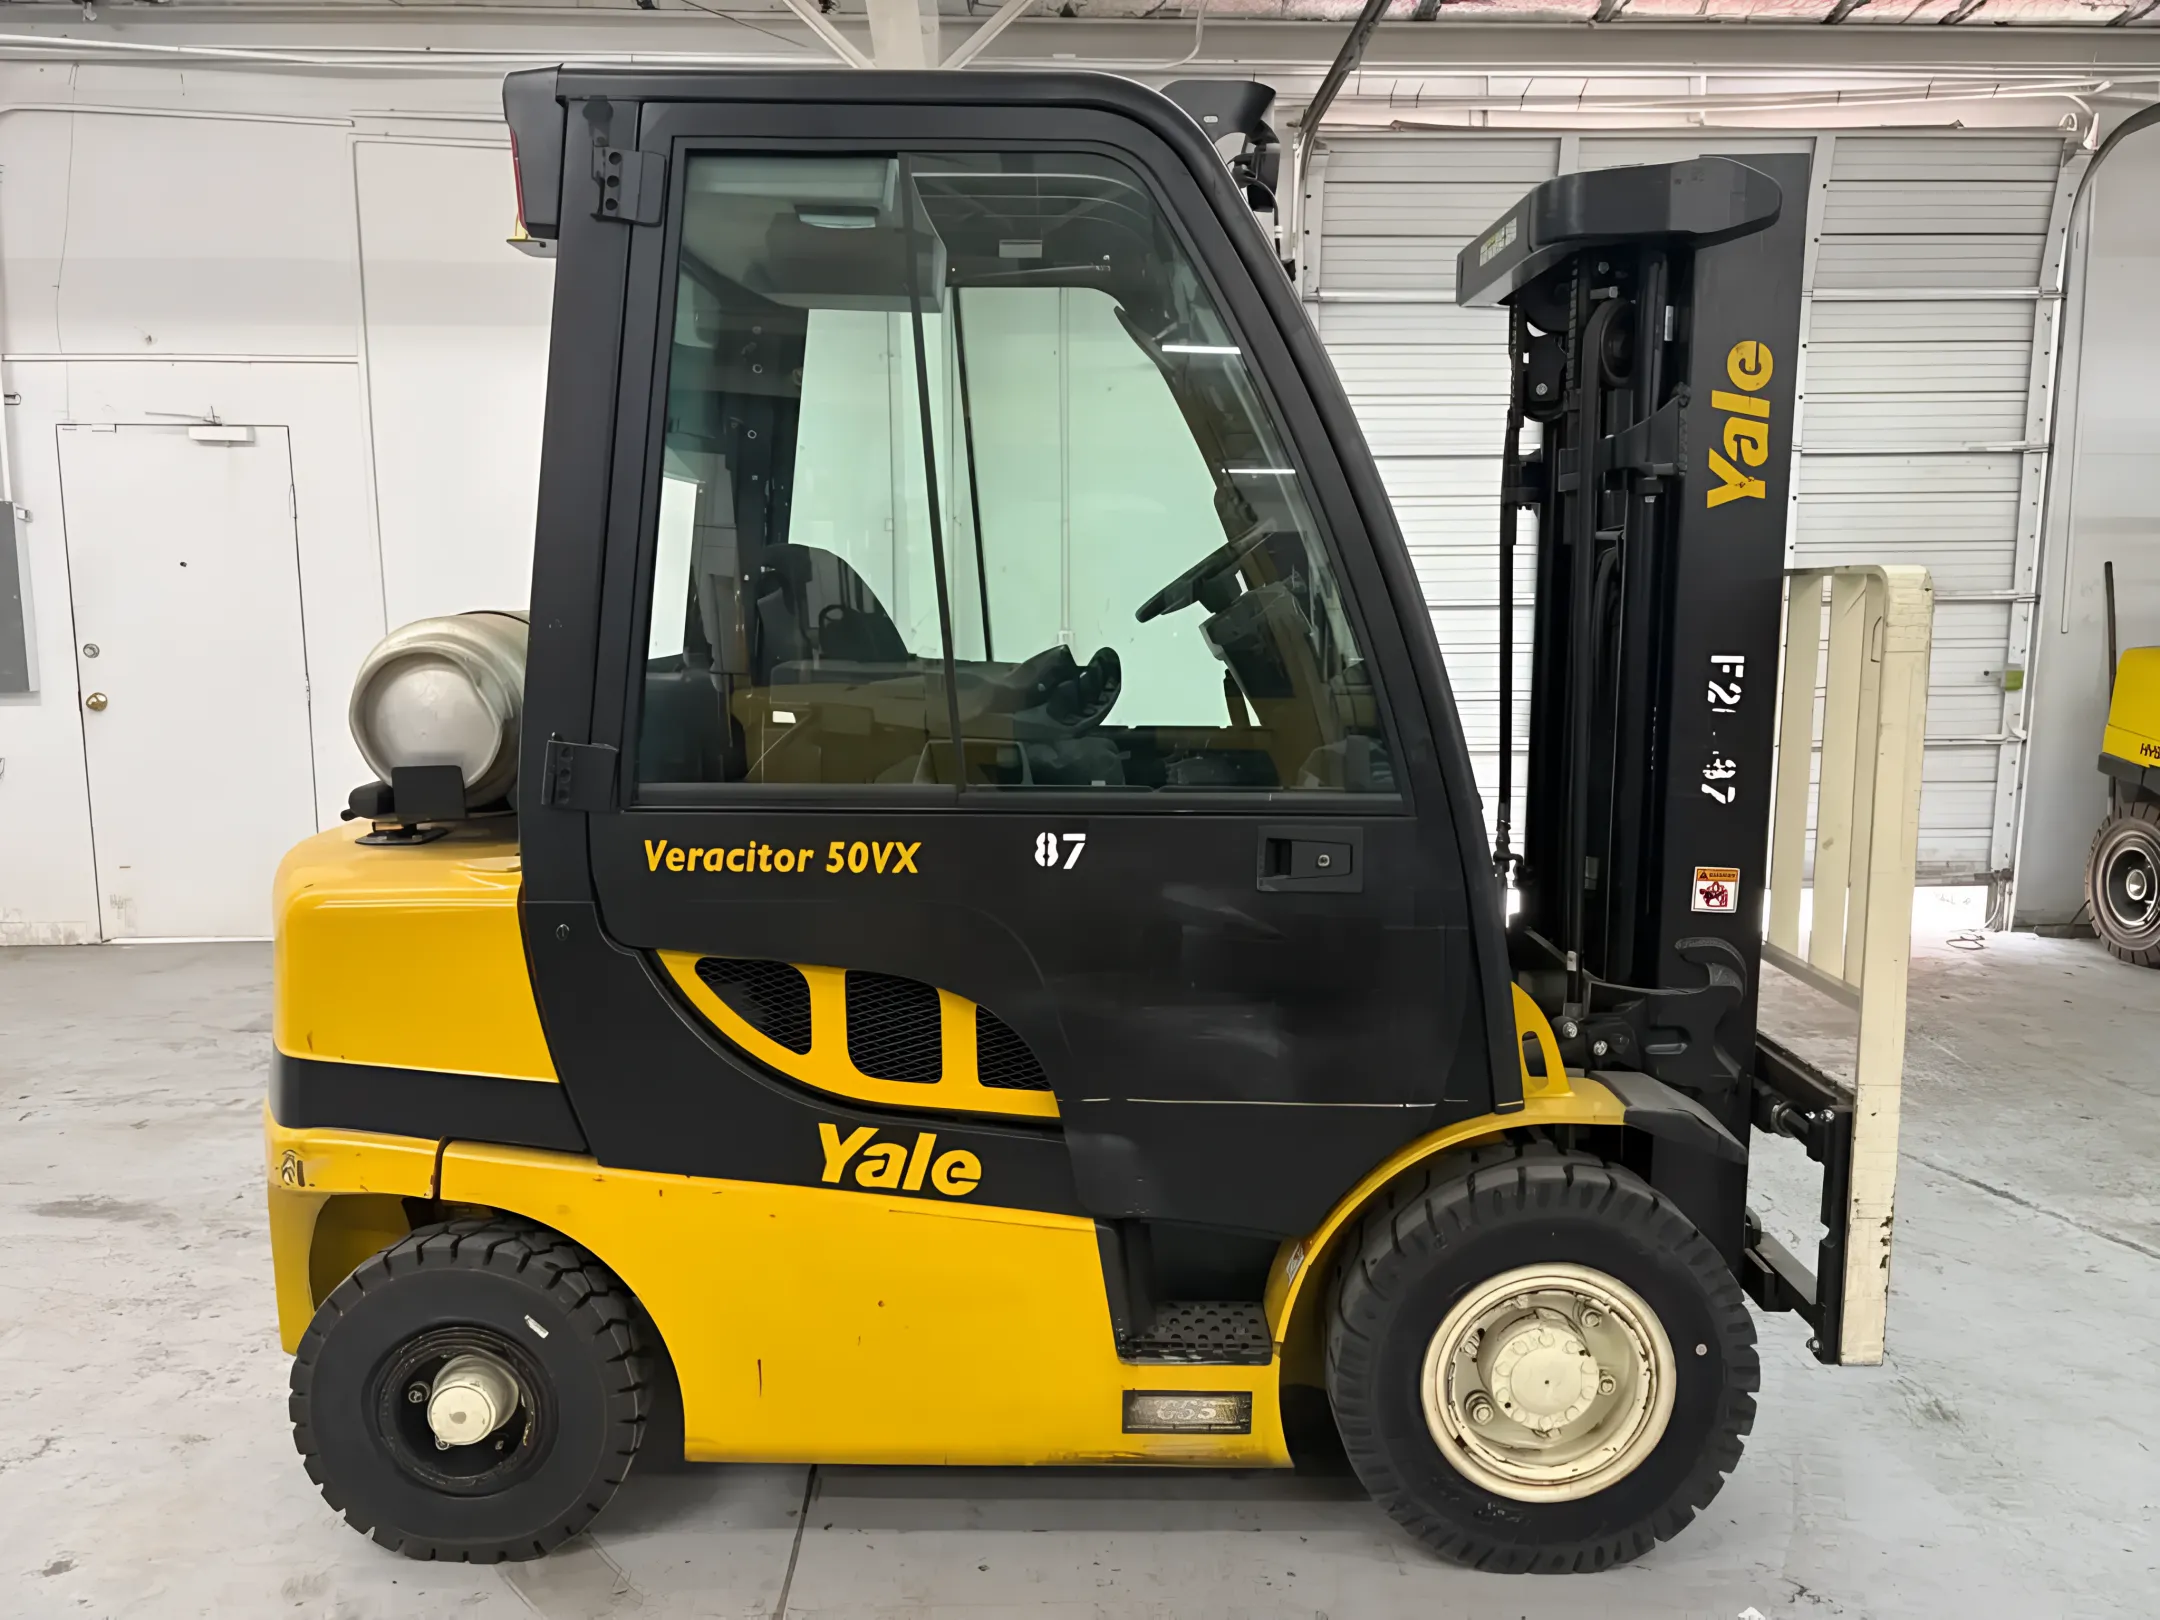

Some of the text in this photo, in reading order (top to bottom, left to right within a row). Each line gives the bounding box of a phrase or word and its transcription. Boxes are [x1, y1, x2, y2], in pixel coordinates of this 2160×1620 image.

[1707, 340, 1774, 508] Yale
[644, 839, 922, 874] Veracitor 50VX
[1034, 831, 1087, 870] 87
[818, 1122, 982, 1196] Yale
